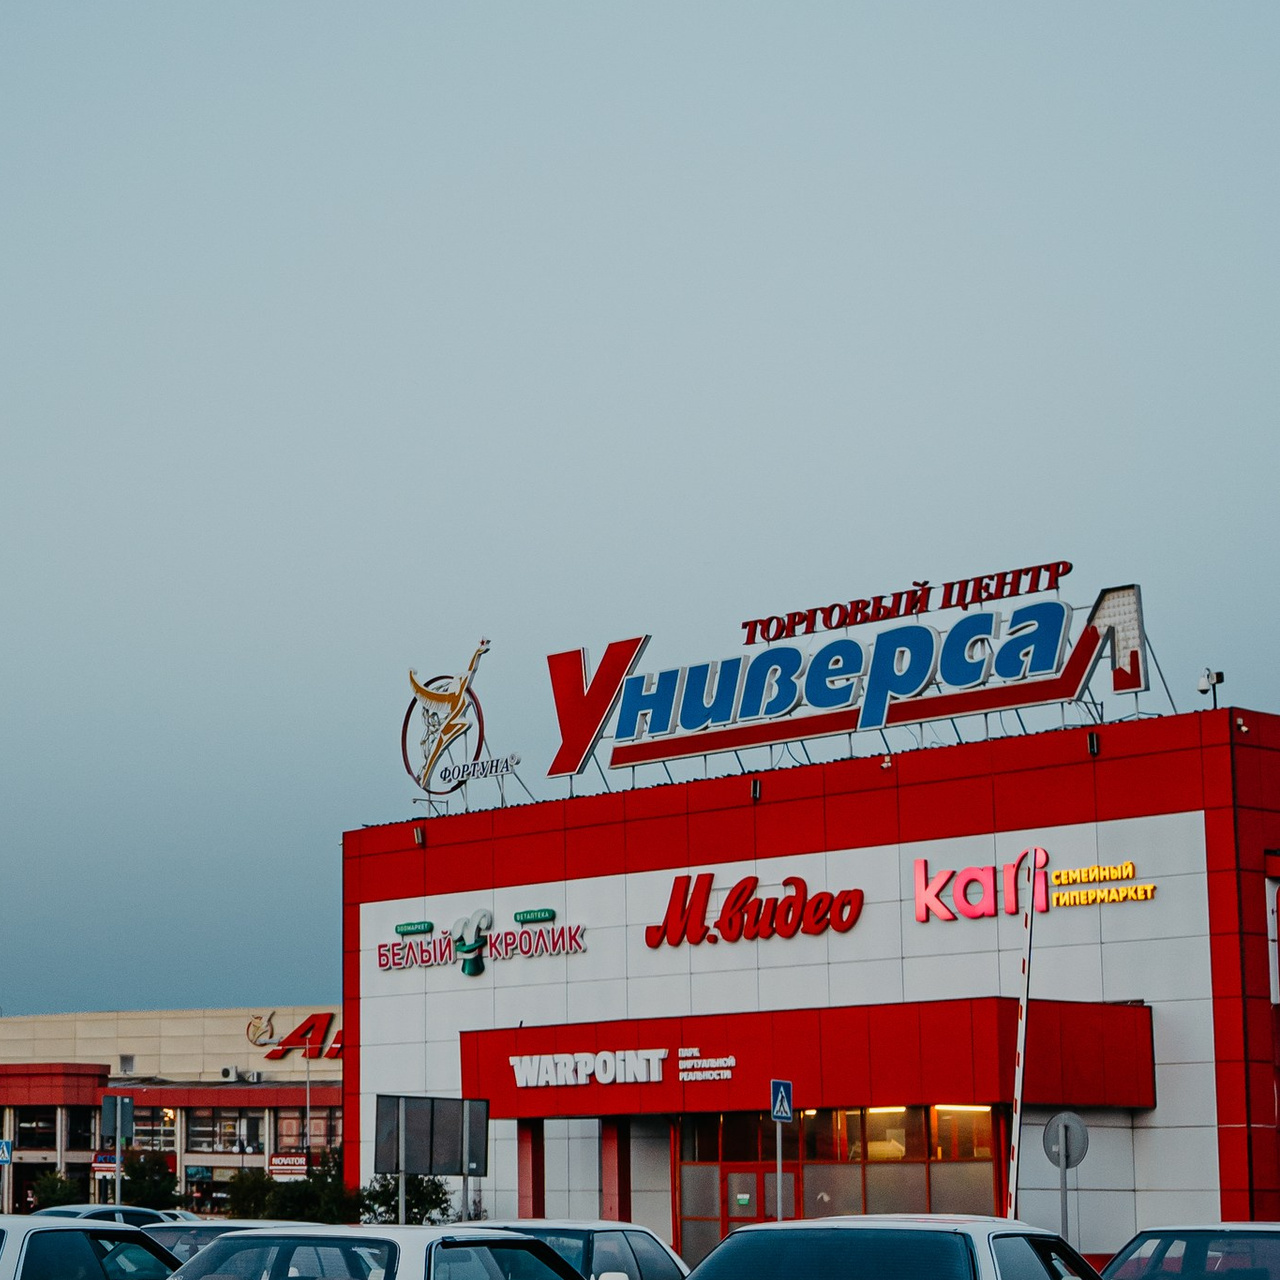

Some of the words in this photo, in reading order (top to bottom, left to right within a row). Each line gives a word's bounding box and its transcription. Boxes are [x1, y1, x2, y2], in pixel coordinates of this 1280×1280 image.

[741, 581, 933, 646] ТОРГОВЫЙ
[938, 561, 1073, 611] ЦЕНТР
[914, 847, 1049, 922] kari
[1051, 861, 1135, 886] СЕМЕЙНЫЙ
[1051, 883, 1157, 908] ГИПЕРМАРКЕТ
[645, 873, 864, 949] М.видео
[377, 930, 455, 969] БЕЛЫЙ
[487, 924, 584, 959] КРОЛИК
[678, 1047, 700, 1057] ПАРК
[678, 1055, 736, 1070] ВИРТУАЛЬНОЙ
[679, 1070, 732, 1081] РЕАЛЬНОСТИ
[271, 1156, 306, 1166] NOVATOR
